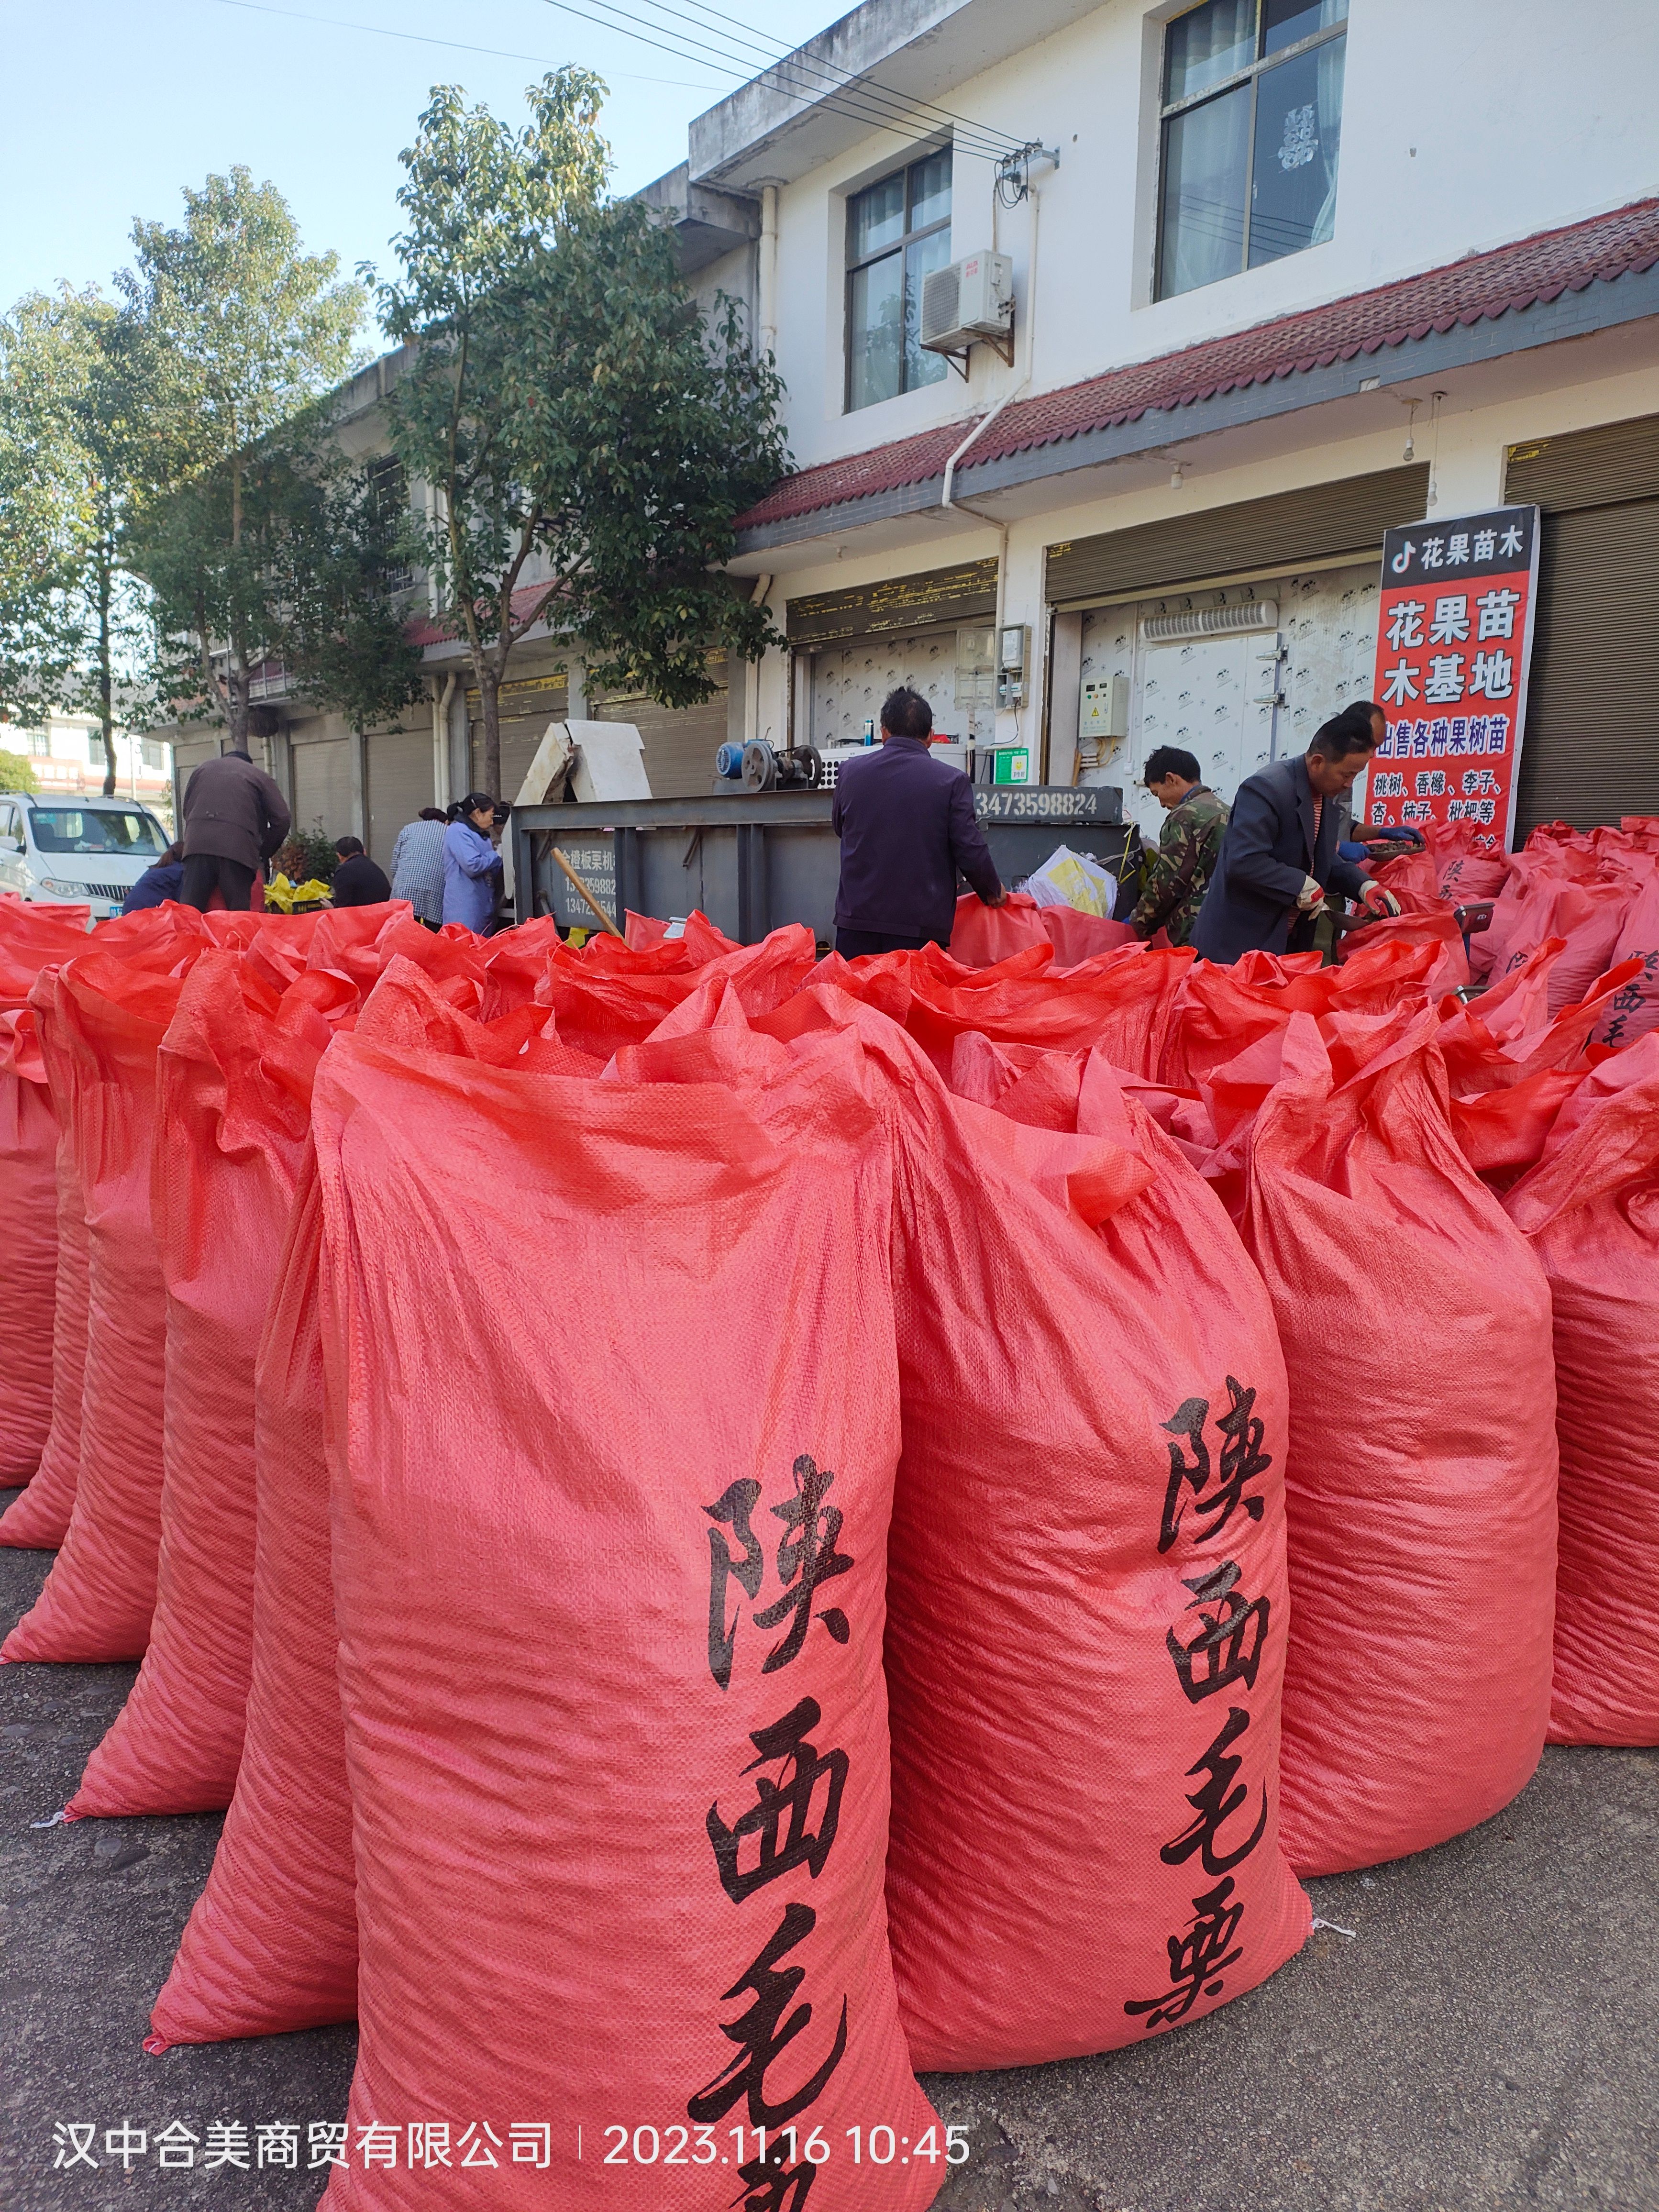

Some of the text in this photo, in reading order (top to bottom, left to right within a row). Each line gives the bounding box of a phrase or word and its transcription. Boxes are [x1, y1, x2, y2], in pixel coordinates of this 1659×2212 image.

[1421, 525, 1523, 570] 花果苗木
[1385, 588, 1521, 651] 花果苗
[1380, 649, 1513, 707] 木基地
[1377, 715, 1508, 757] 出售各种果树苗
[976, 793, 1097, 815] 3473598824
